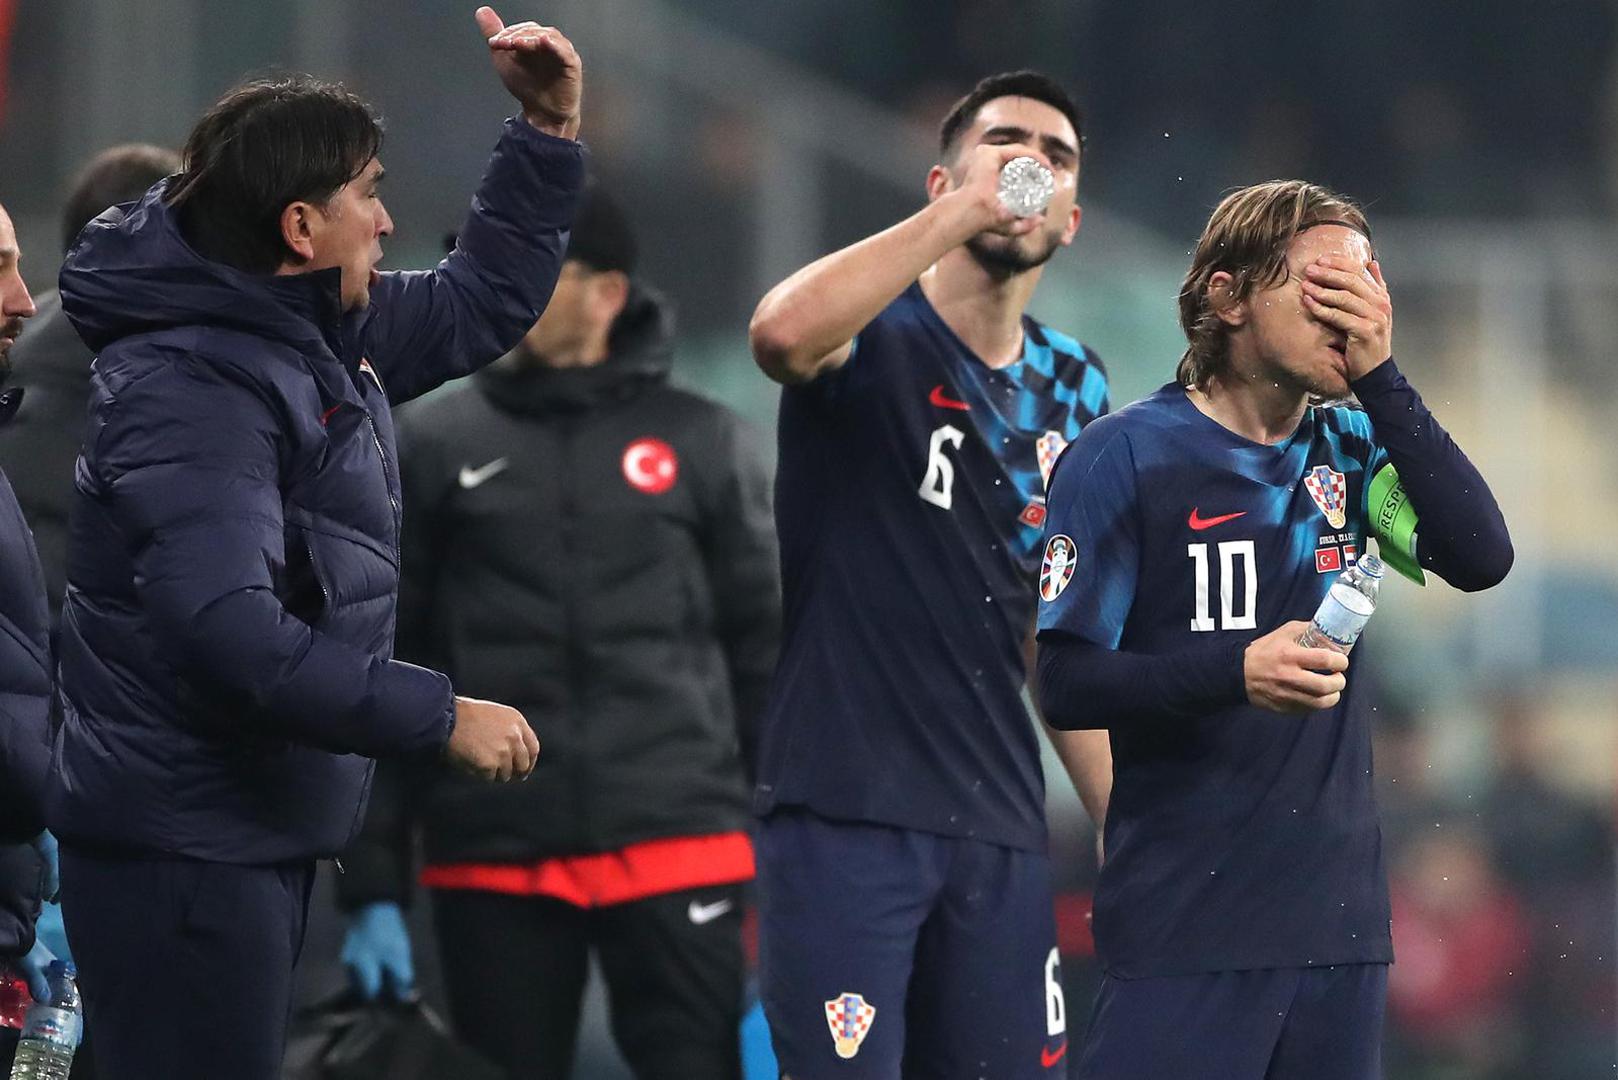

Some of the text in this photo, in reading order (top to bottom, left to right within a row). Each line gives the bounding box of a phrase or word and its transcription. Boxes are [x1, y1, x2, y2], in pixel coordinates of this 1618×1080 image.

[918, 424, 965, 510] 6
[1187, 540, 1258, 632] 10
[1044, 946, 1067, 1037] 6
